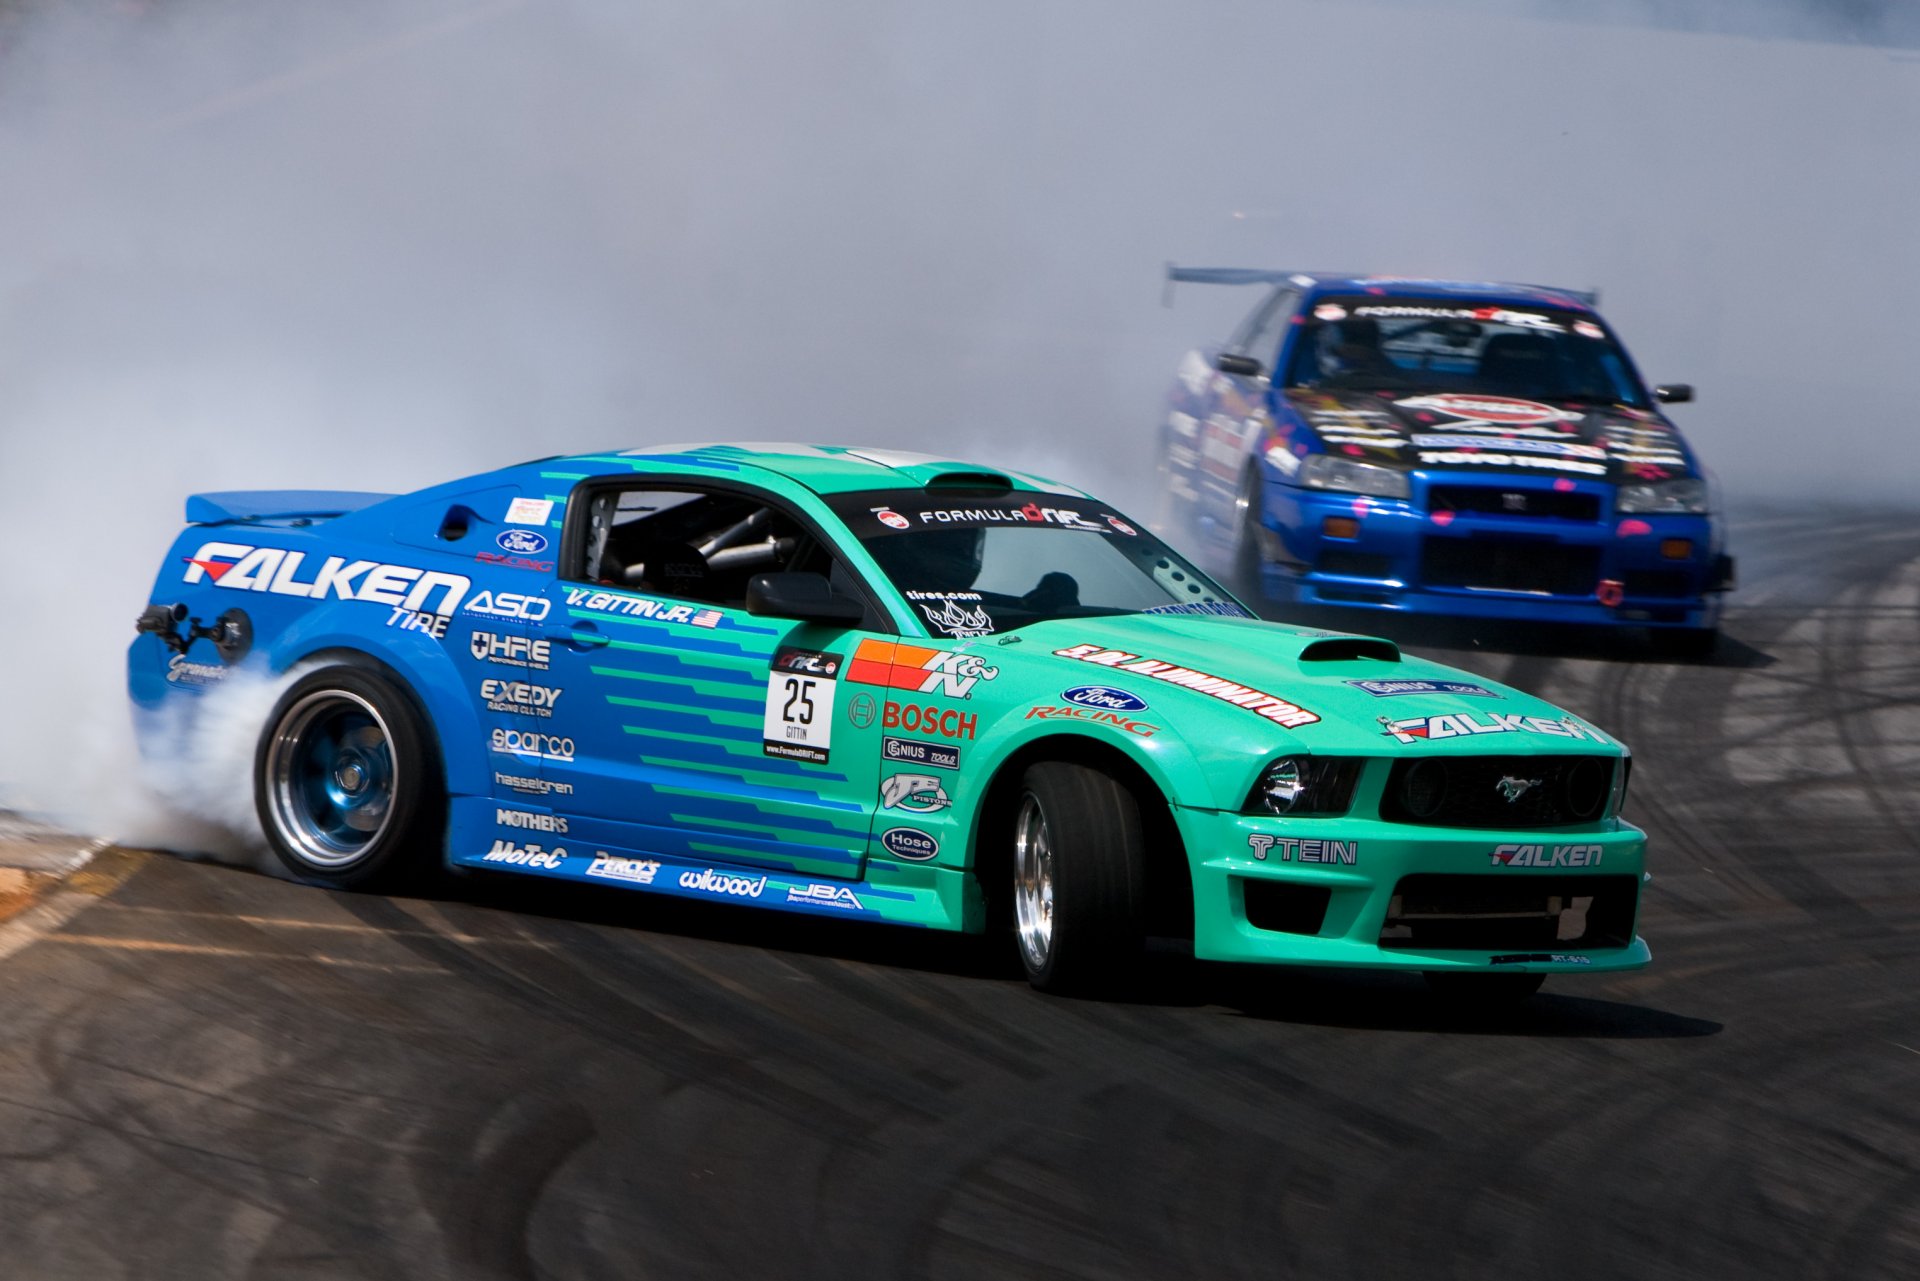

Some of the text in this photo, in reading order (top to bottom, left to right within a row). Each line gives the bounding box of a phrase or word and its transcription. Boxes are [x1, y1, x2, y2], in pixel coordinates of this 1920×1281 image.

[919, 509, 1027, 524] FORMULA
[475, 552, 555, 572] RACING
[182, 541, 471, 617] FALKEN
[464, 590, 551, 621] ASD
[585, 593, 663, 617] GITTIN
[906, 590, 982, 600] tires.com
[386, 607, 451, 638] TIRE
[490, 634, 551, 663] HRE
[918, 650, 999, 699] K&N
[480, 679, 563, 708] EXEDY
[783, 678, 816, 725] 25
[487, 701, 518, 713] RACING
[786, 725, 807, 741] GITTIN
[884, 701, 977, 740] BOSCH
[1024, 706, 1161, 737] RACING
[1384, 713, 1609, 744] FALKEN
[492, 728, 575, 757] sparco
[930, 752, 956, 766] TOOLS
[495, 772, 574, 795] hasselgren
[912, 794, 953, 807] PISTONS
[497, 809, 569, 834] MOTHERS
[891, 833, 932, 849] Hose
[892, 844, 931, 856] Techniques
[1276, 837, 1357, 865] TEIN
[482, 840, 568, 869] MoTeC
[1489, 844, 1603, 867] FALKEN
[679, 868, 767, 898] wilwood
[789, 884, 863, 909] JBA
